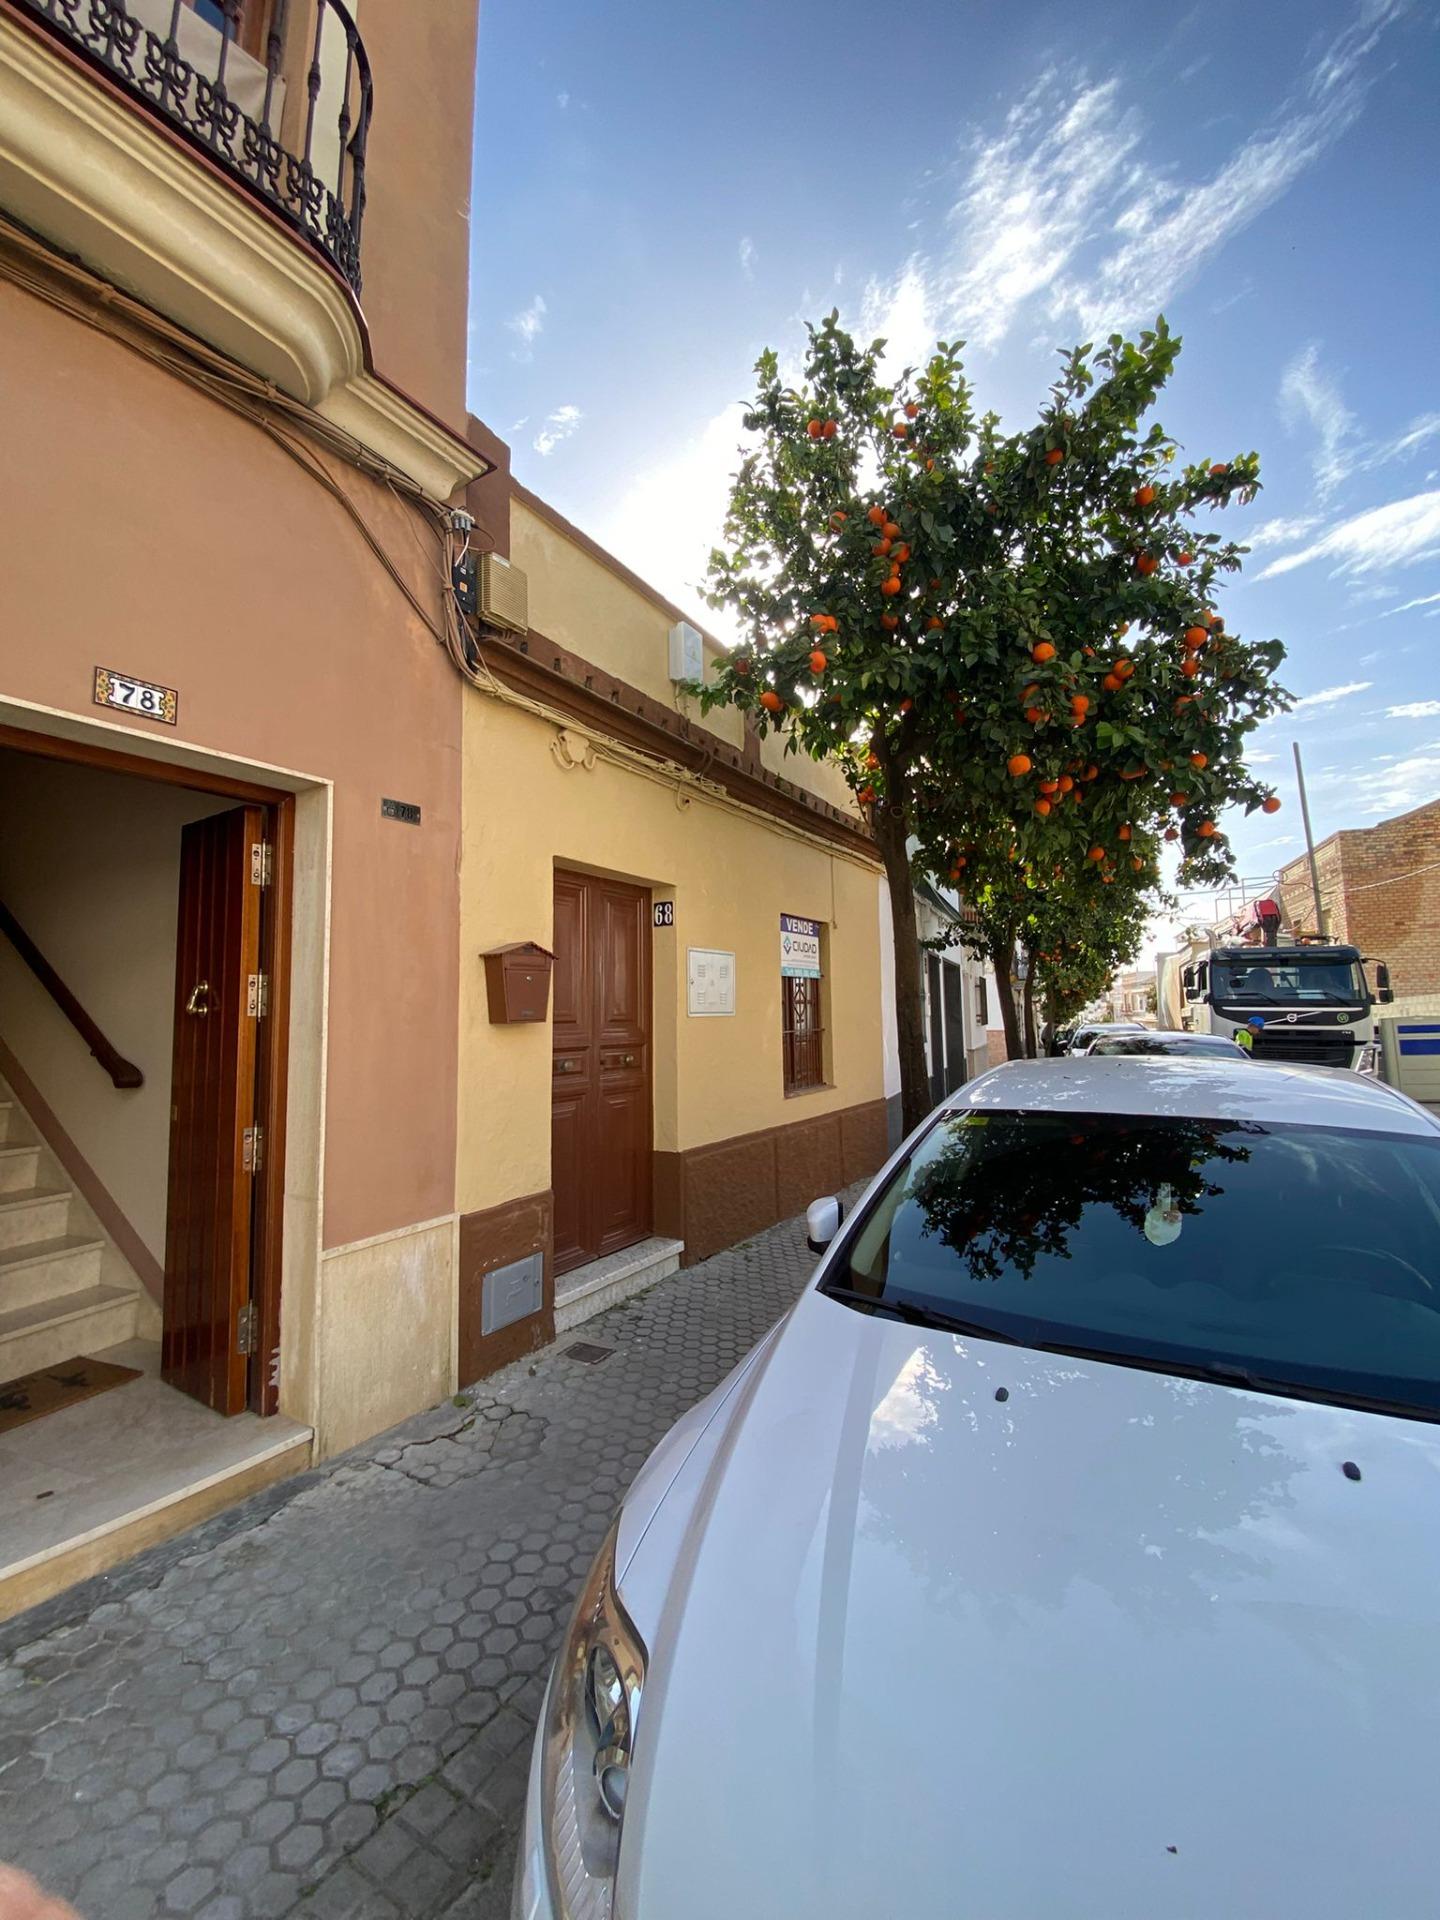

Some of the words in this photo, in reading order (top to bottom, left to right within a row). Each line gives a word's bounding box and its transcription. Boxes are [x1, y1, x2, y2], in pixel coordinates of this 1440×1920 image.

[119, 682, 155, 710] 78
[655, 903, 673, 925] 68
[786, 917, 814, 935] VENDE
[792, 940, 817, 954] CIUDAD
